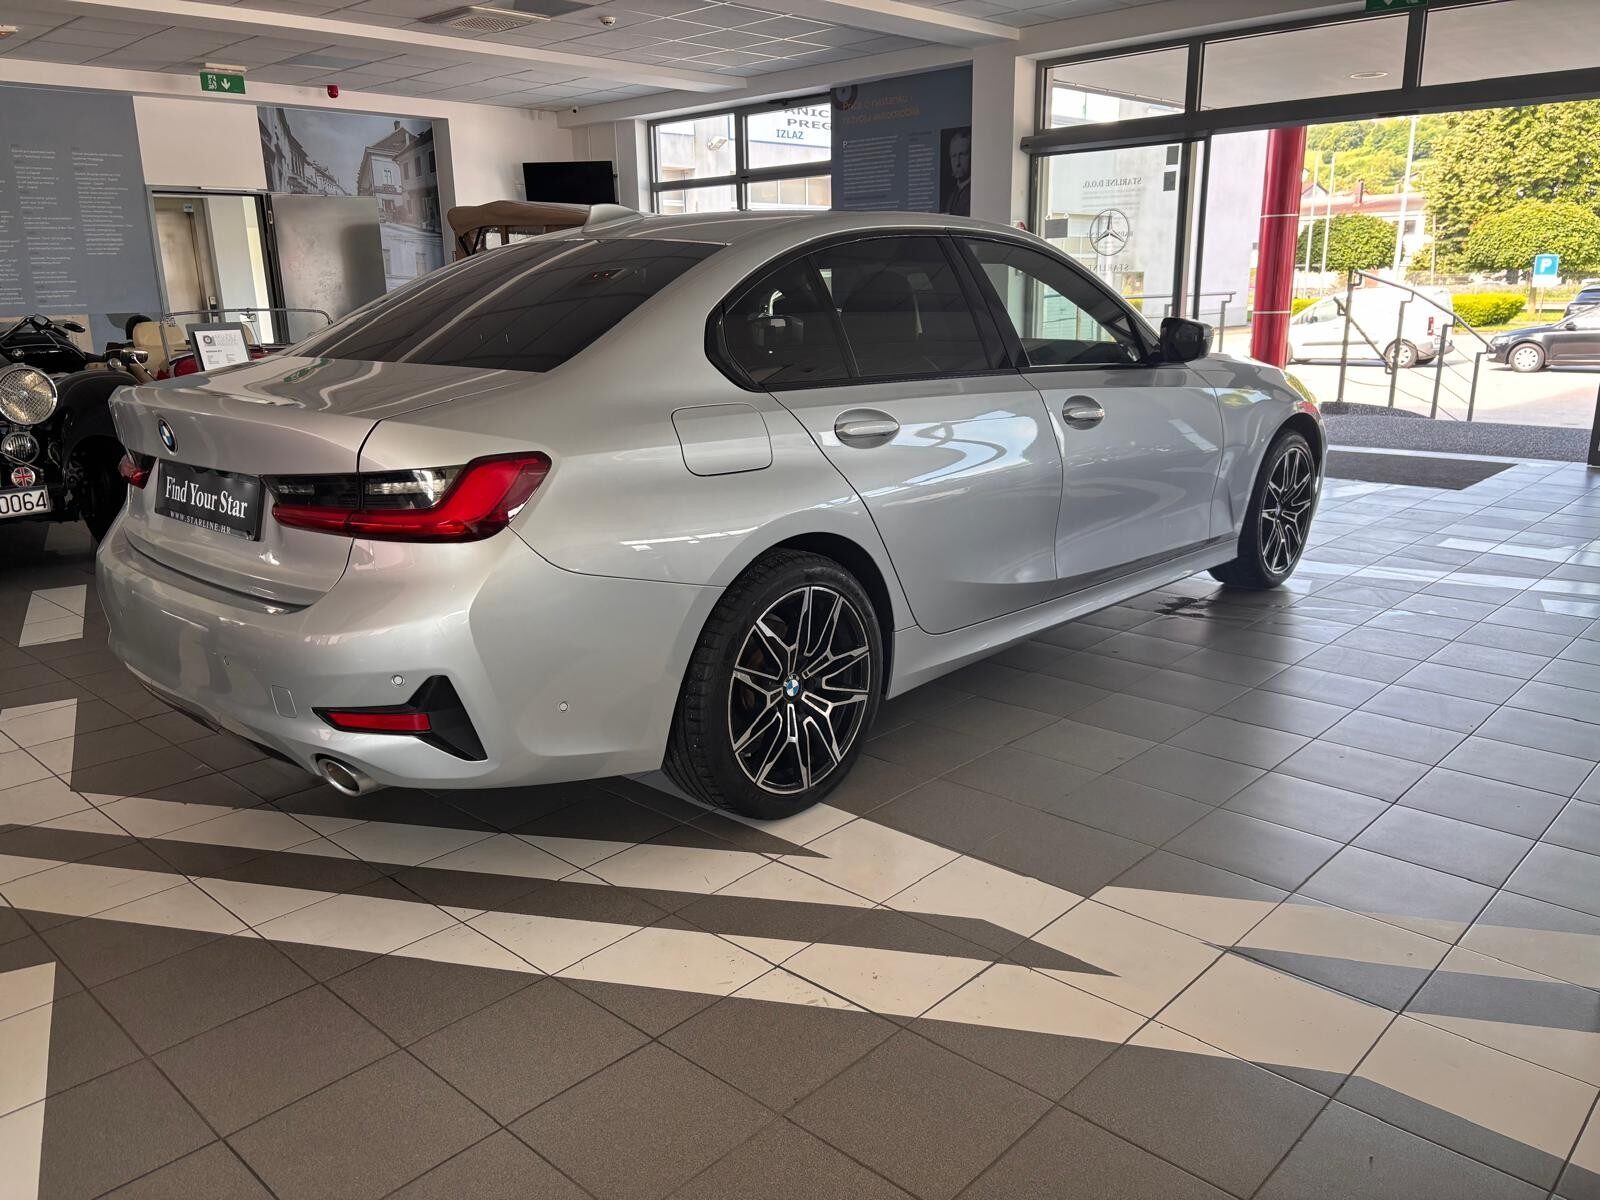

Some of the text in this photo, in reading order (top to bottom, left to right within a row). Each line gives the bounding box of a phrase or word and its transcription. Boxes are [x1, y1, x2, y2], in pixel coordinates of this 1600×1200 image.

[776, 129, 804, 139] IZLAZ
[1540, 258, 1552, 272] P
[0, 491, 47, 514] 0064
[165, 475, 248, 519] Find Your Star
